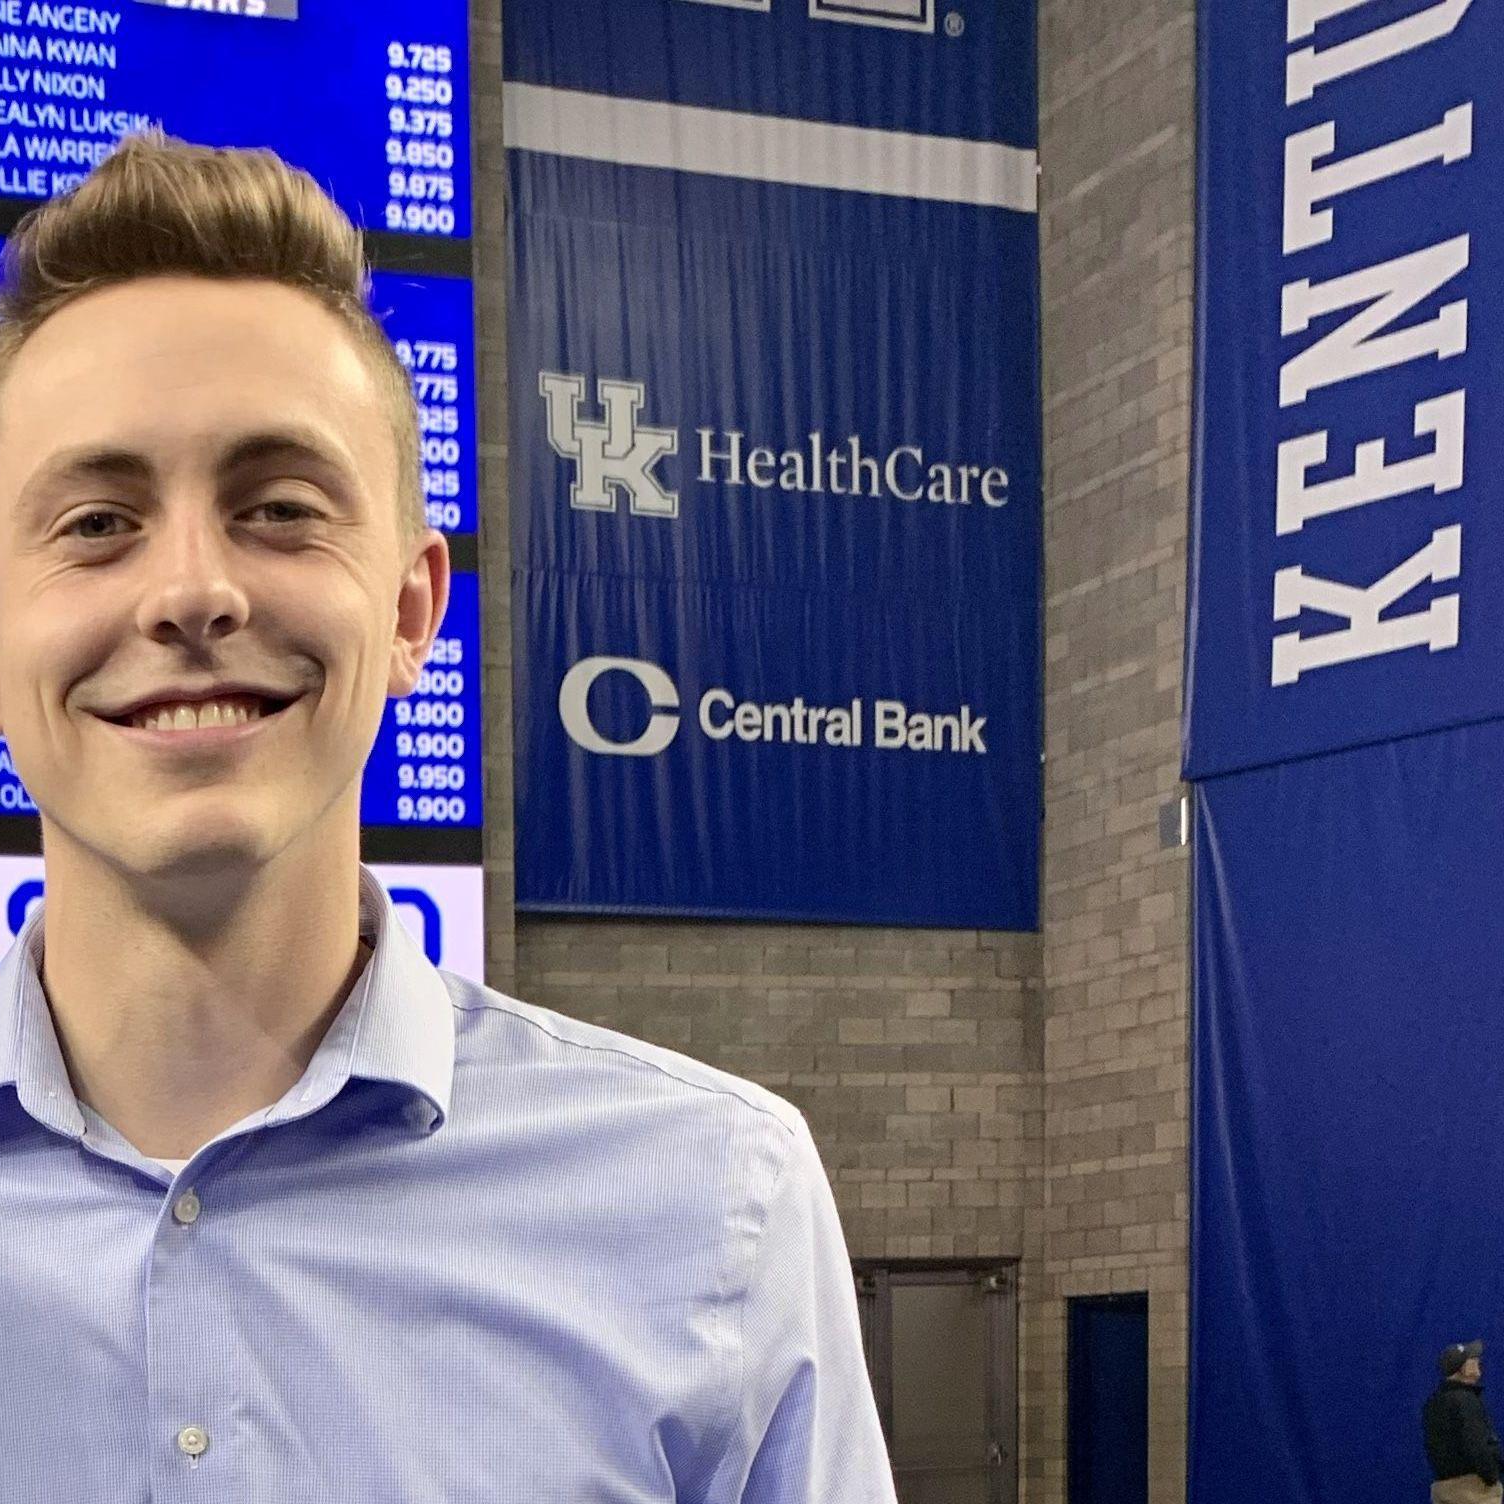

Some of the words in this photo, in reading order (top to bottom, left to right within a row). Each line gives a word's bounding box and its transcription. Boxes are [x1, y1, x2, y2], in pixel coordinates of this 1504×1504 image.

[26, 3, 120, 35] ANGENY
[46, 37, 117, 69] KWAN
[387, 41, 452, 73] 9.725
[33, 69, 105, 100] NIXON
[385, 74, 453, 105] 9.250
[388, 106, 453, 137] 9.375
[385, 138, 454, 170] 9.850
[388, 170, 454, 202] 9.875
[385, 202, 455, 233] 9.900
[696, 428, 1009, 508] HealthCare
[395, 700, 464, 728] 9.800
[699, 688, 862, 747] Central
[874, 699, 988, 755] Bank
[396, 732, 465, 759] 9.900
[398, 764, 465, 791] 9.950
[397, 795, 466, 822] 9.900
